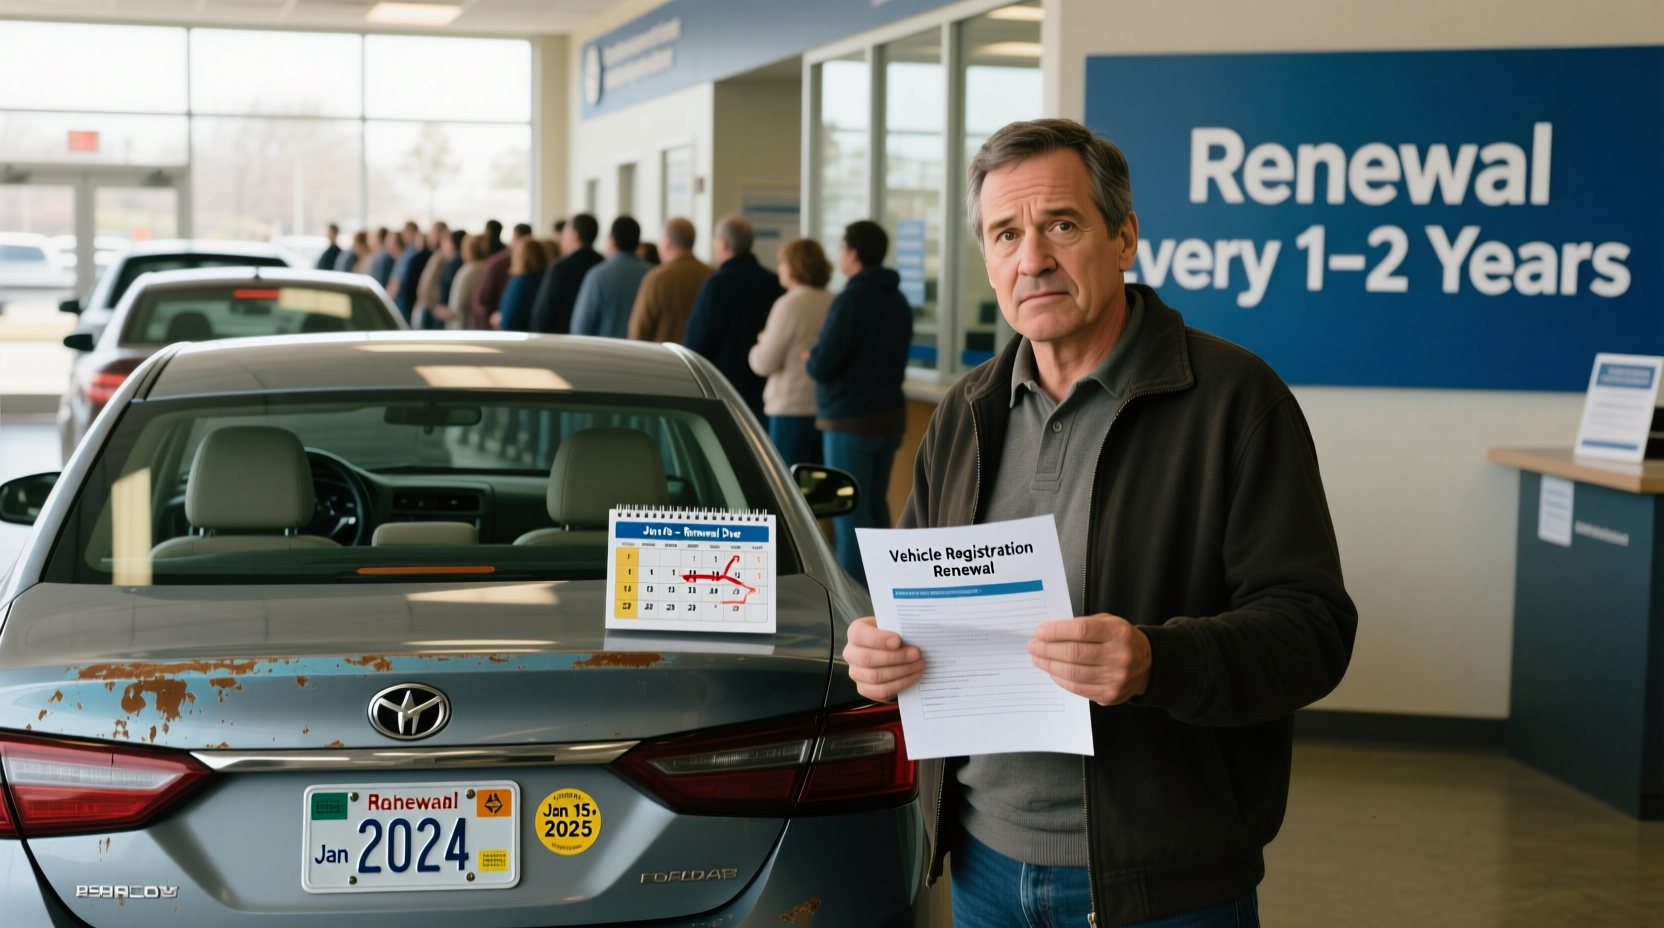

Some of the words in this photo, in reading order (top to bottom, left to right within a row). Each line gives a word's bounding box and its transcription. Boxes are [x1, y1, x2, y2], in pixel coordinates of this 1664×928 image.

[1189, 122, 1552, 206] Renewal
[1124, 238, 1283, 308] very
[1425, 225, 1632, 298] Years
[889, 547, 942, 563] Vehicle
[945, 541, 1034, 563] Registration
[933, 560, 995, 578] Renewal
[543, 803, 568, 817] Jan
[544, 820, 593, 838] 2025
[315, 844, 348, 864] Jan
[358, 818, 469, 873] 2024
